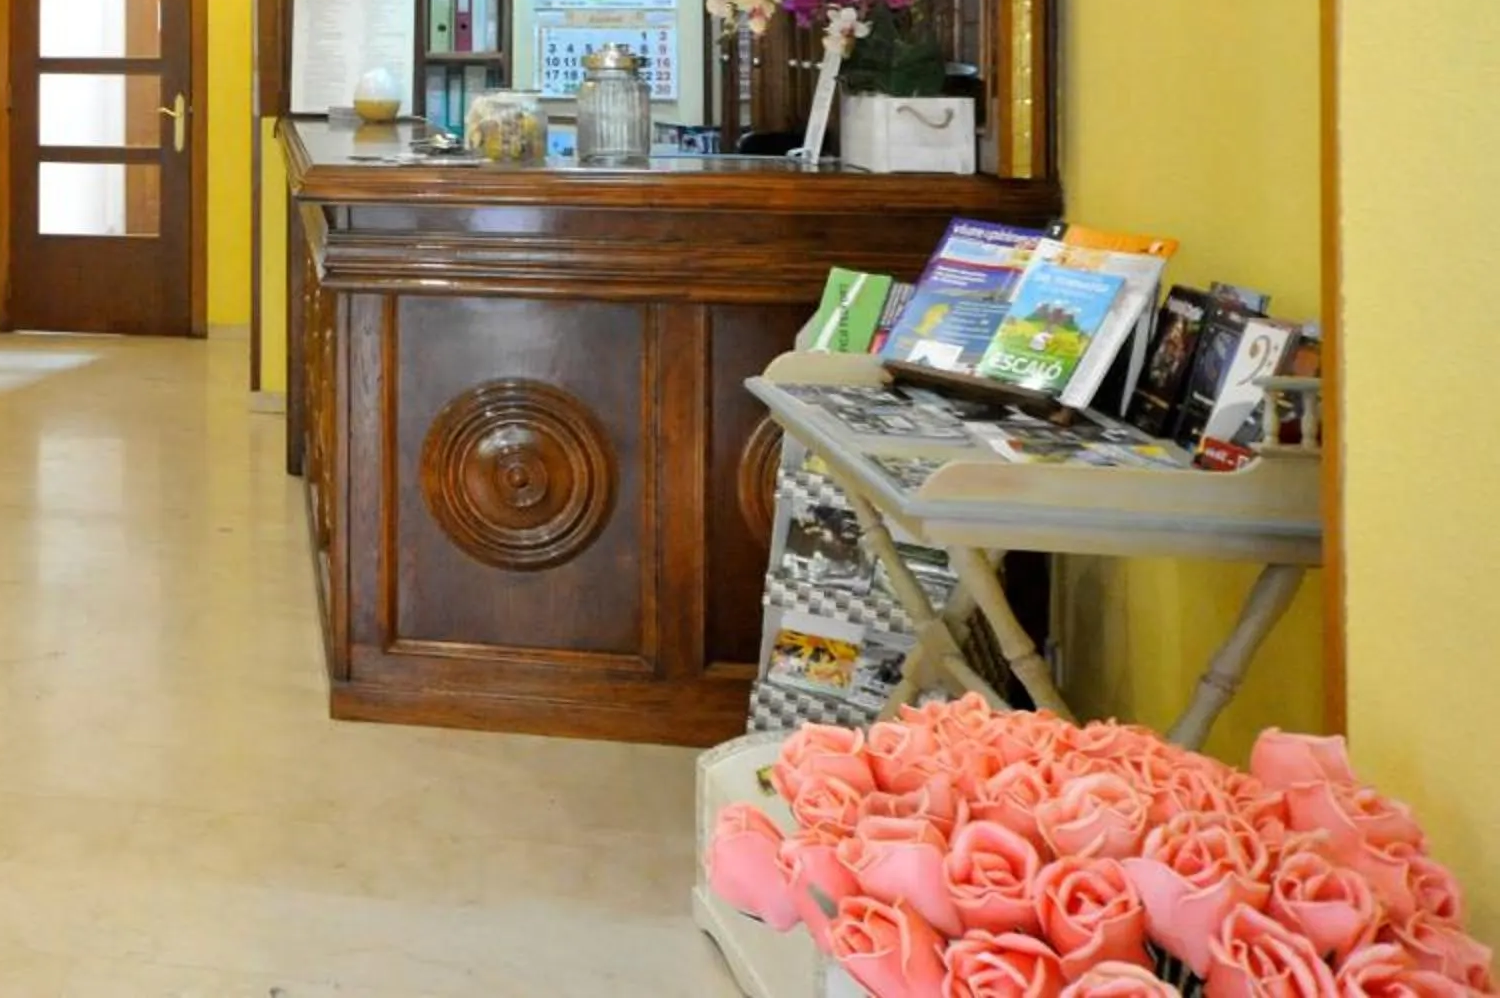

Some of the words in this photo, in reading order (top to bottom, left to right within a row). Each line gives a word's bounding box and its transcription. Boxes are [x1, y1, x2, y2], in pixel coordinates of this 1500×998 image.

[548, 44, 556, 54] 3
[567, 44, 574, 53] 4
[546, 57, 560, 66] 10
[563, 57, 577, 66] 11
[657, 58, 670, 67] 16
[546, 70, 559, 80] 17
[991, 353, 1063, 382] ESCALÓ
